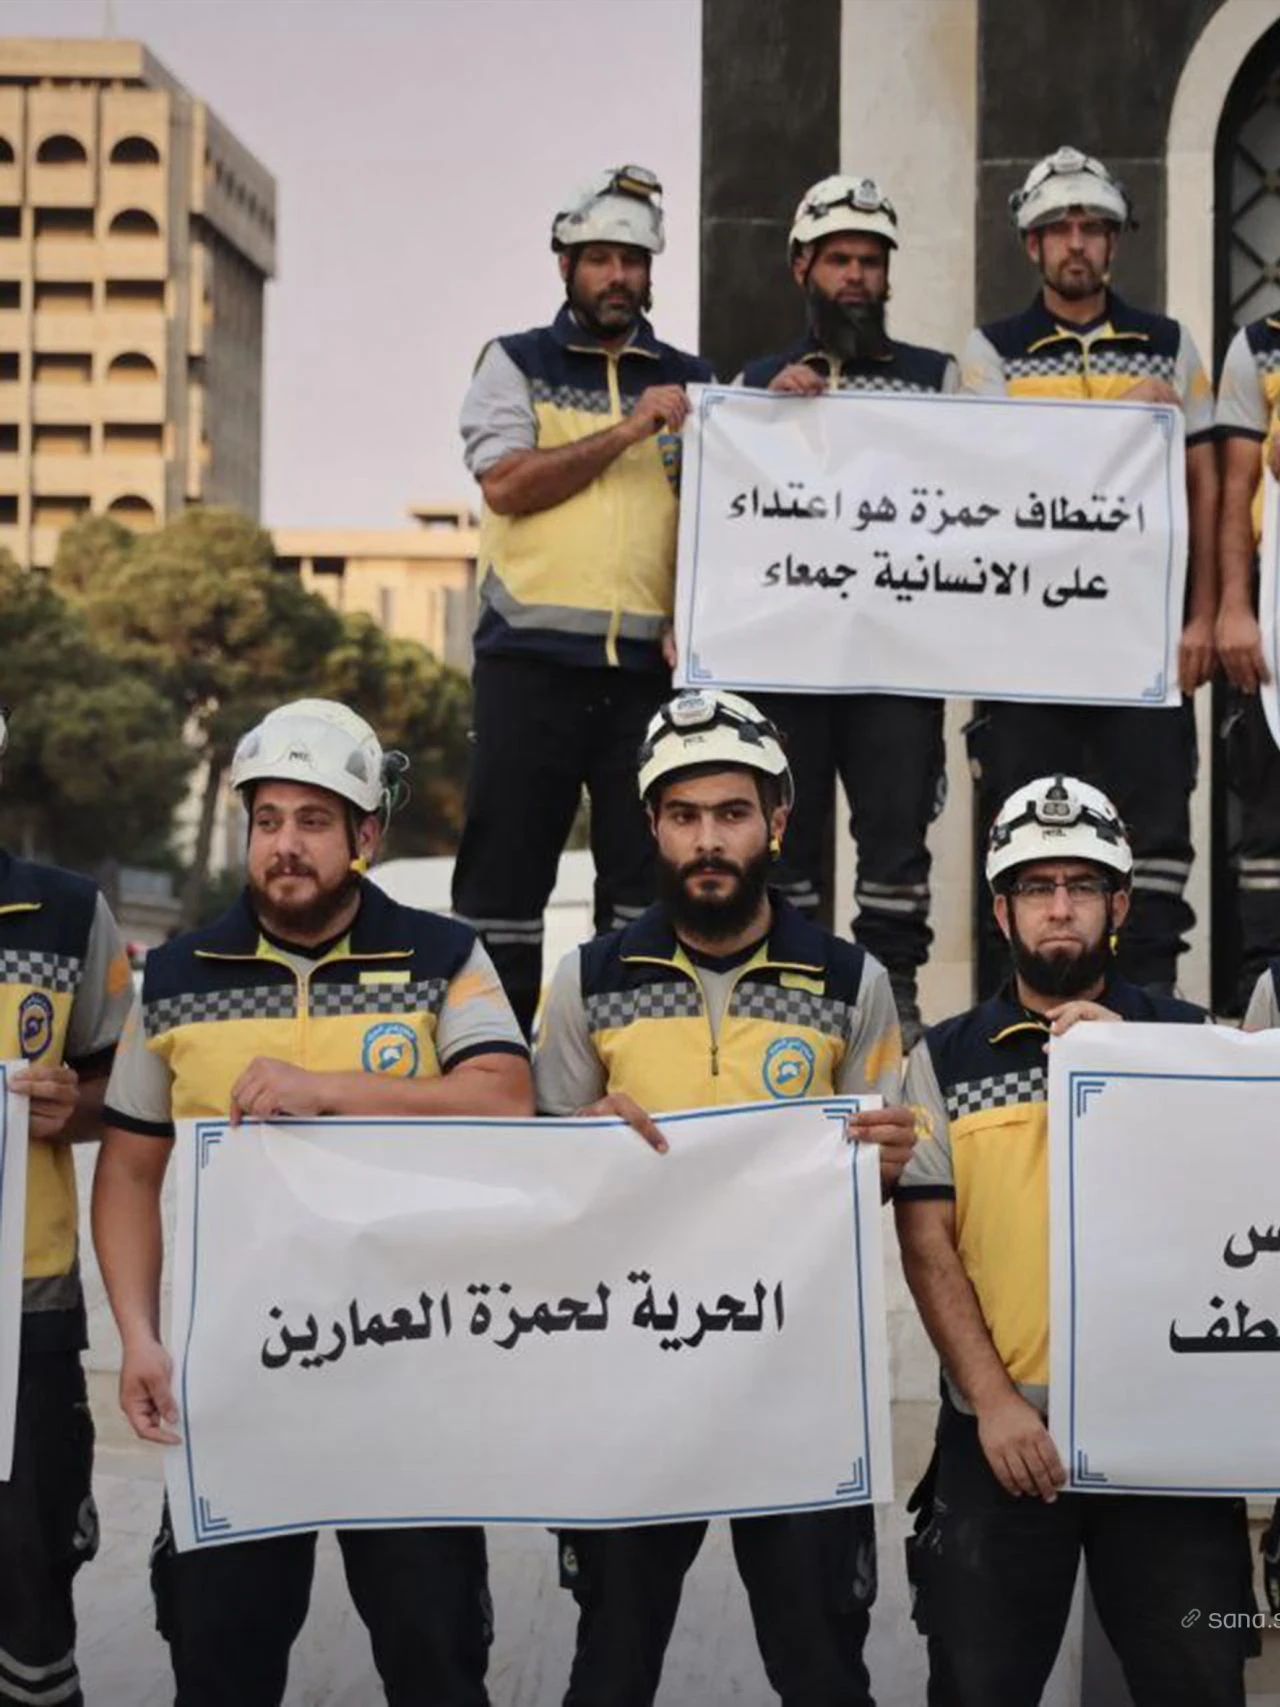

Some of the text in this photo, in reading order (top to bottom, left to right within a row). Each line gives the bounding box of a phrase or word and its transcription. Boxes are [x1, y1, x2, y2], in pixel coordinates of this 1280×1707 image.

[730, 482, 1144, 536] اختطاف حمزة هو اعتداء
[764, 550, 1110, 609] على الانسانية جمعاء
[260, 1269, 785, 1371] الحرية لحمزة العمارين
